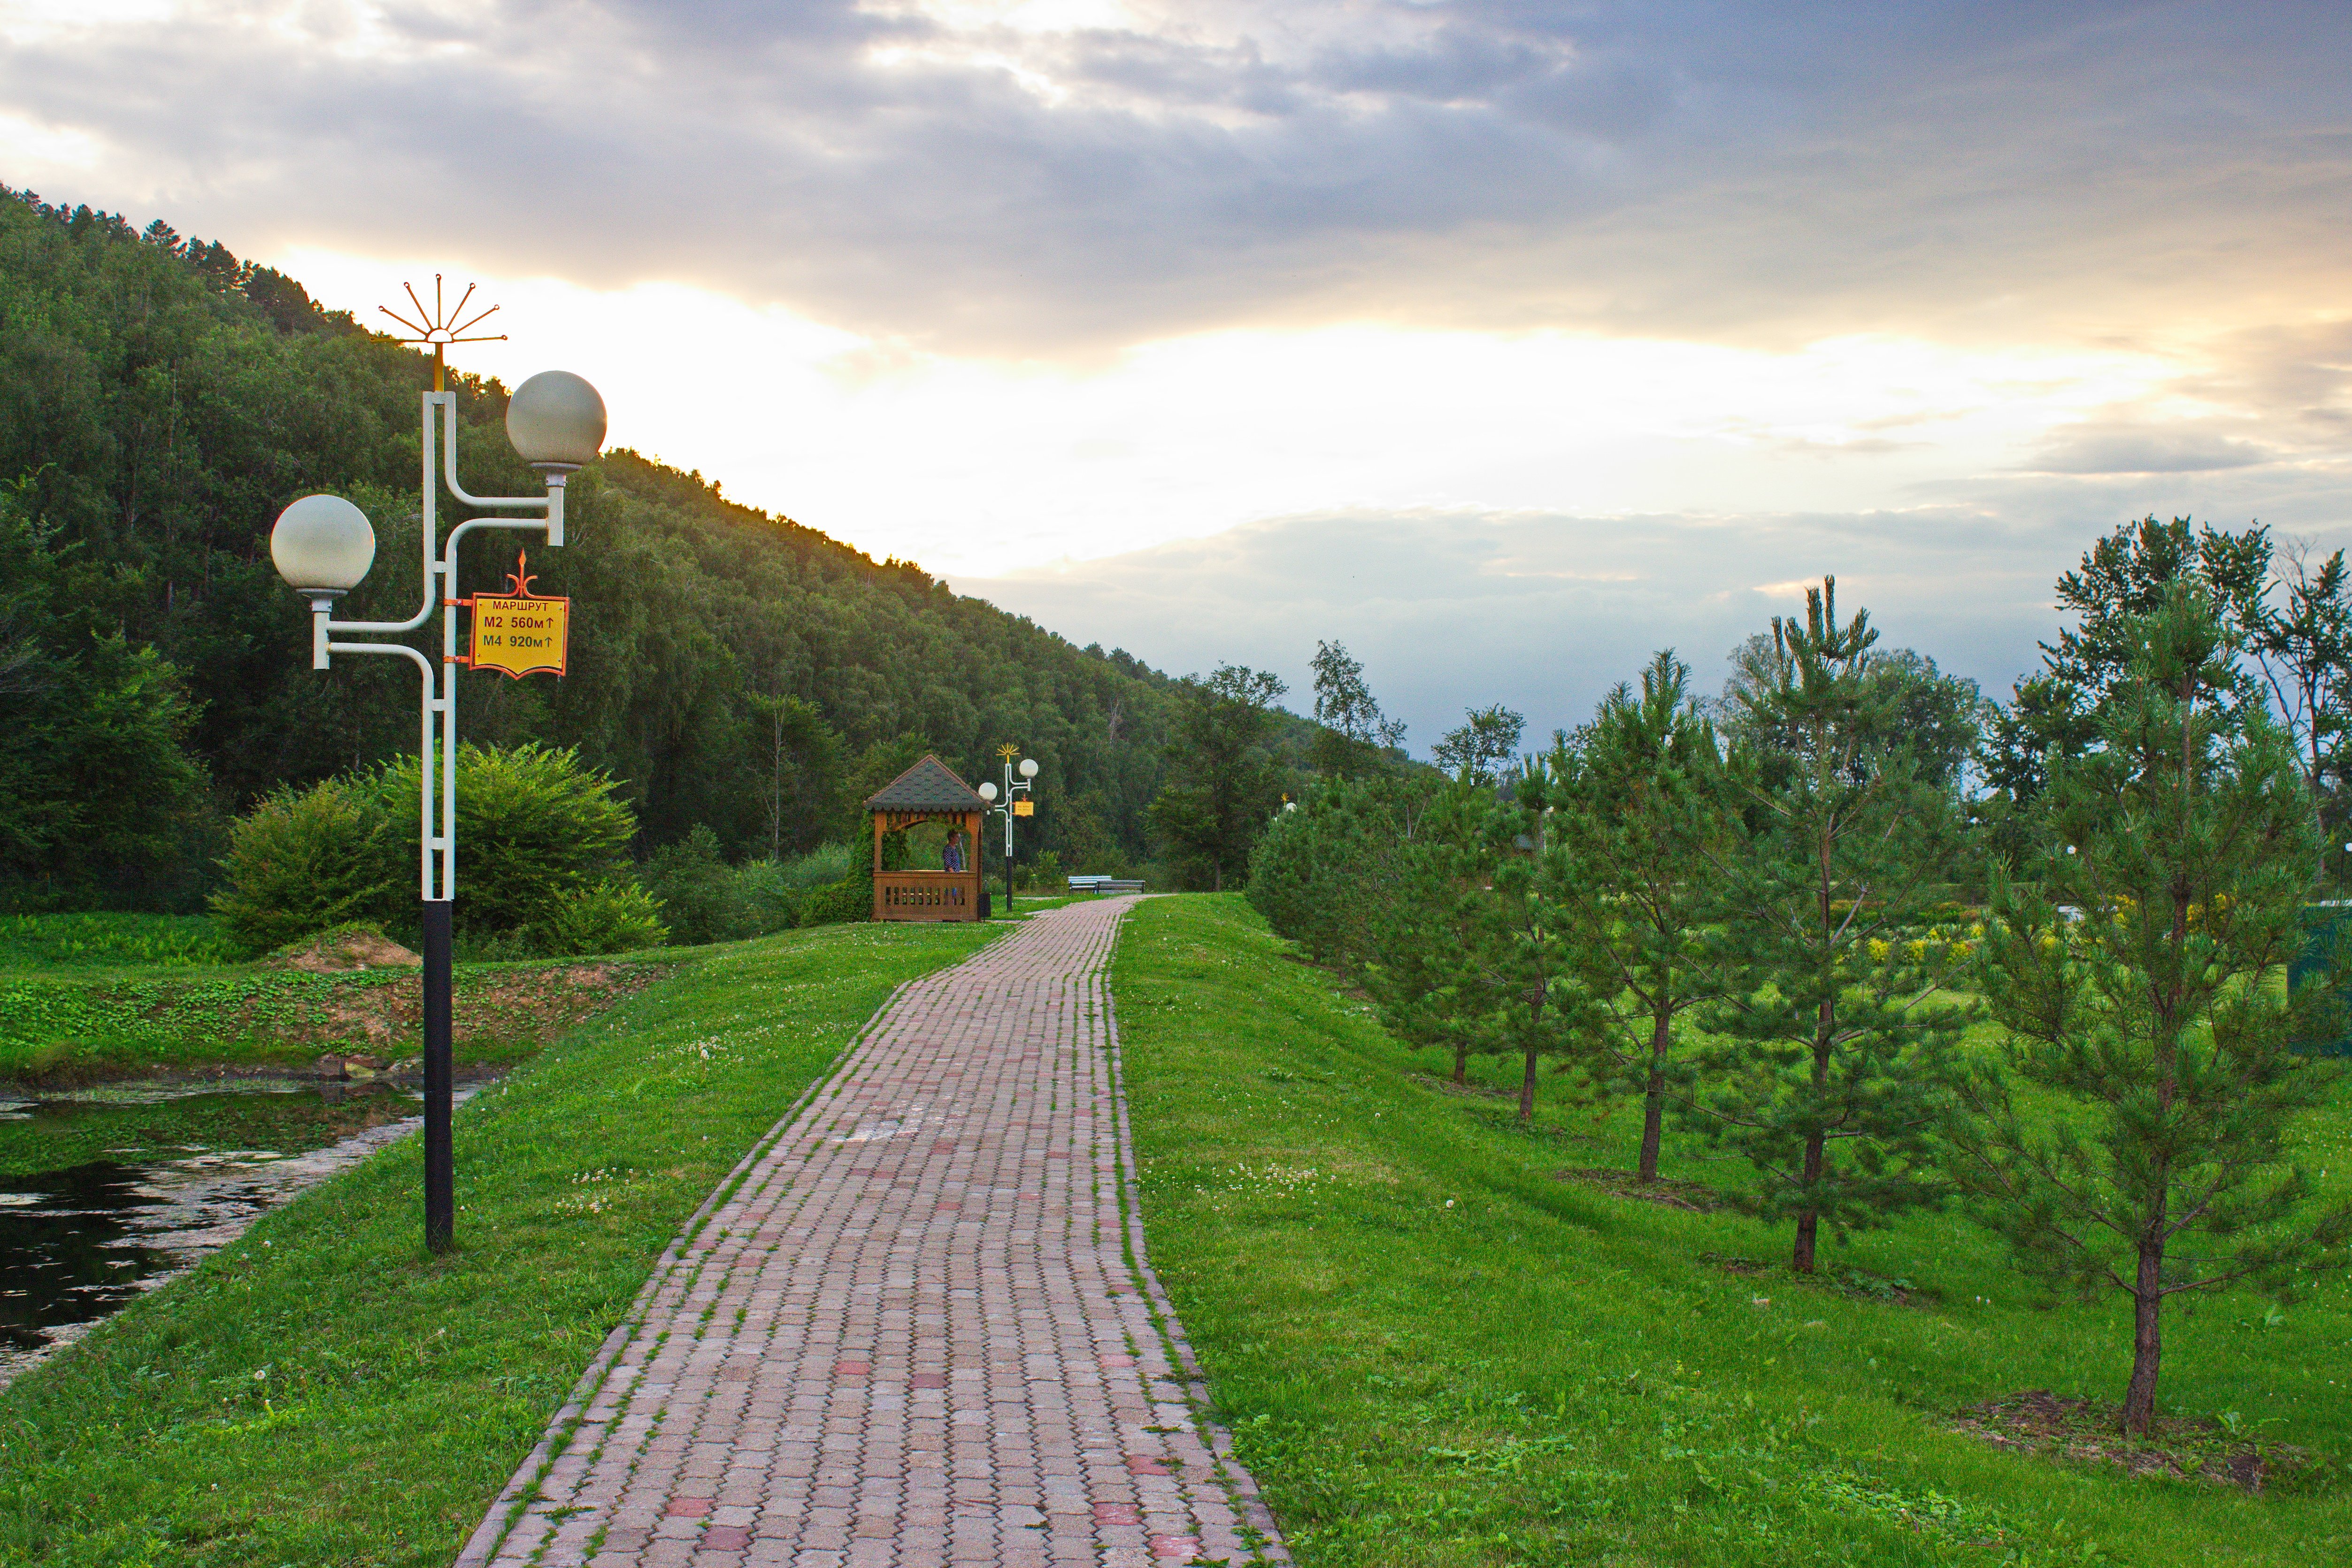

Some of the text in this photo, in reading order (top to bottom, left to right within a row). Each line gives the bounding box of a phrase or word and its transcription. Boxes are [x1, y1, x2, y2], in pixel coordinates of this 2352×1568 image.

[493, 601, 548, 611] МАРШРУТ
[484, 617, 543, 628] М2 560м
[484, 635, 542, 647] М4 920м
